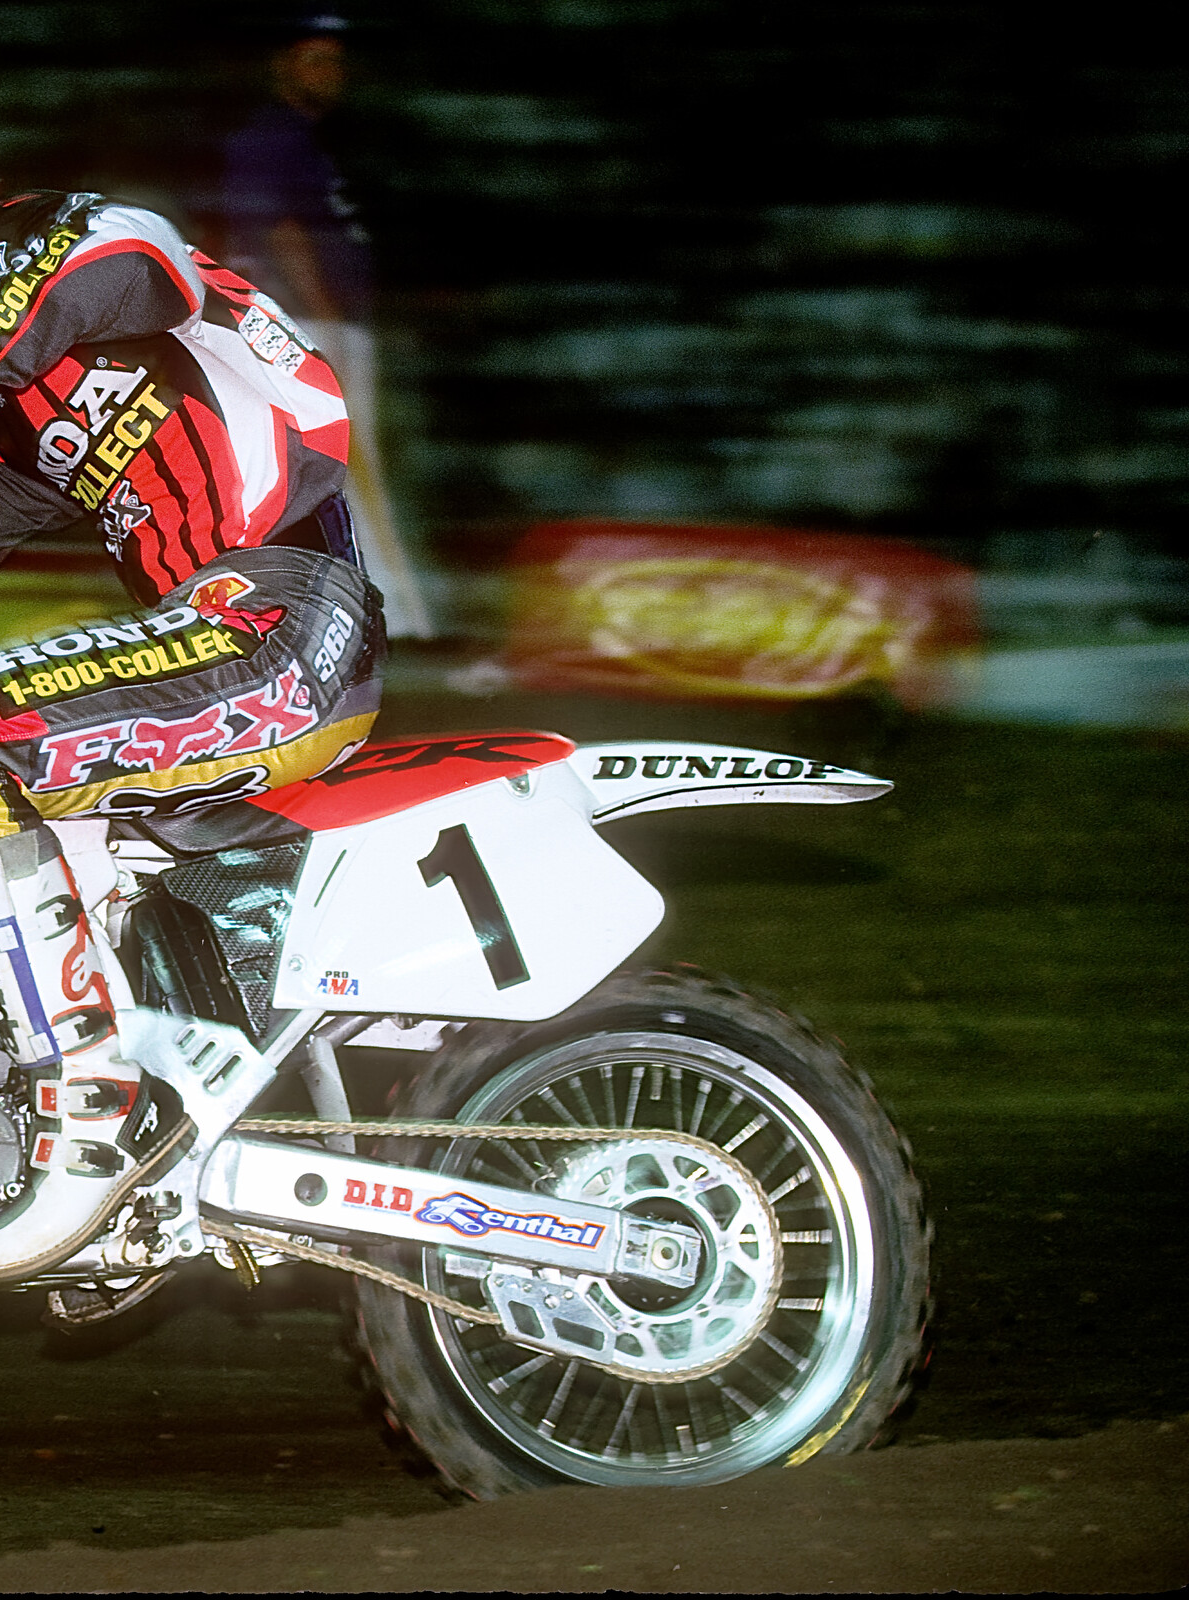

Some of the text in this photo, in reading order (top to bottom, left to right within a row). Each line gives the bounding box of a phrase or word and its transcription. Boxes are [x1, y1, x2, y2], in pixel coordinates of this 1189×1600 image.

[70, 382, 170, 512] OLLECT
[314, 605, 354, 683] 360
[417, 823, 530, 991] 1
[316, 978, 359, 996] AMA
[420, 1192, 599, 1246] Renthal
